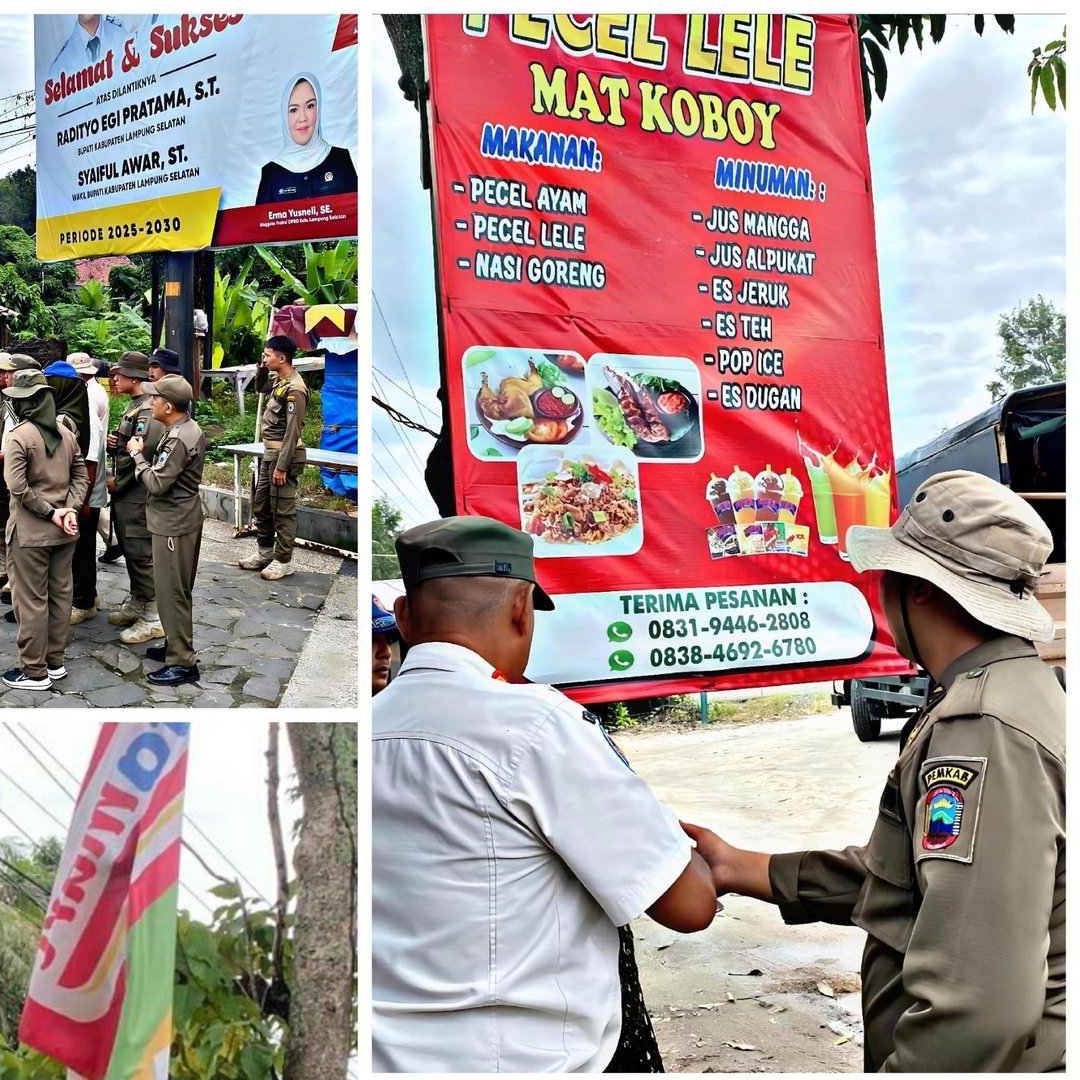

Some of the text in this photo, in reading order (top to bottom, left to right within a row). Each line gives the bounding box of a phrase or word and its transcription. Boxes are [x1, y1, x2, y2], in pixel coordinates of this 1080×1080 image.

[684, 14, 815, 94] LELE
[44, 49, 114, 105] Selamat
[121, 37, 140, 73] &
[95, 74, 157, 105] ATAS DILANTIKNYA
[57, 75, 221, 147] RADITYO EGI PRATAMA, S.T.
[529, 62, 782, 150] MAT KOBOY
[77, 115, 186, 156] BUPATI KABUPATEN LAMPUNG SELATAN
[482, 124, 602, 172] MAKANAN:
[77, 144, 189, 187] SYAIFUL AWAR, ST.
[715, 158, 815, 200] MINUMAN:
[71, 166, 200, 202] WAKIL BUPATI KABUPATEN LAMPUNG SELATAN
[470, 177, 588, 216] PECEL AYAM
[268, 204, 333, 220] Erma Yusneli, SE.
[706, 210, 810, 242] JUS MANGGA
[59, 216, 181, 244] PERIODE 2025-2030
[473, 214, 586, 251] PECEL LELE
[475, 254, 607, 290] NASI GORENG
[709, 245, 816, 276] JUS ALPUKAT
[711, 279, 790, 308] ES JERUK
[715, 314, 773, 341] ES TEH
[718, 349, 784, 376] POP ICE
[721, 385, 802, 411] ES DUGAN
[620, 594, 700, 615] TERIMA
[704, 588, 798, 611] PESANAN
[648, 612, 811, 639] 0831-9446-2808
[649, 638, 817, 668] 0838-4692-6780
[926, 767, 969, 784] PEMKAB
